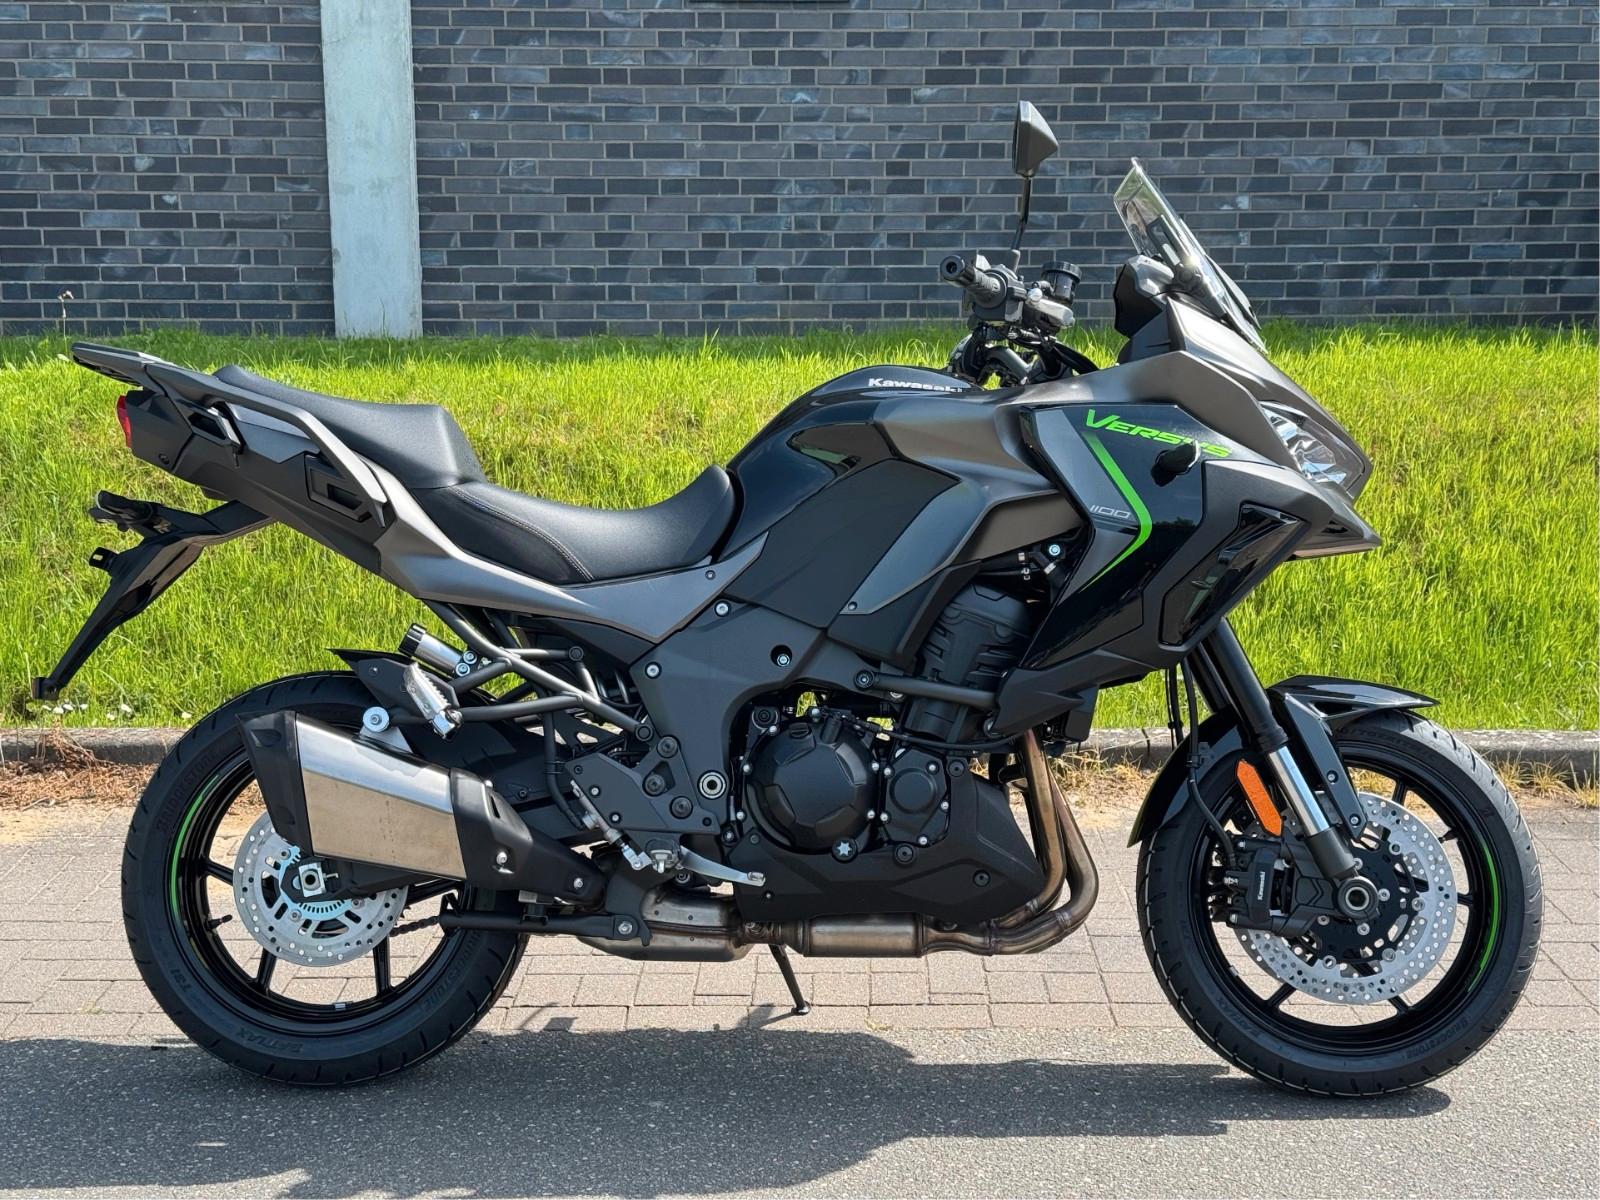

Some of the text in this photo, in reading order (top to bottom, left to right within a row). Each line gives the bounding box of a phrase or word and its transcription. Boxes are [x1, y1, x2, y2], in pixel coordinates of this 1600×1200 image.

[868, 378, 963, 392] Kawasaki
[1090, 505, 1131, 519] 1100
[1257, 871, 1266, 901] Kawasaki
